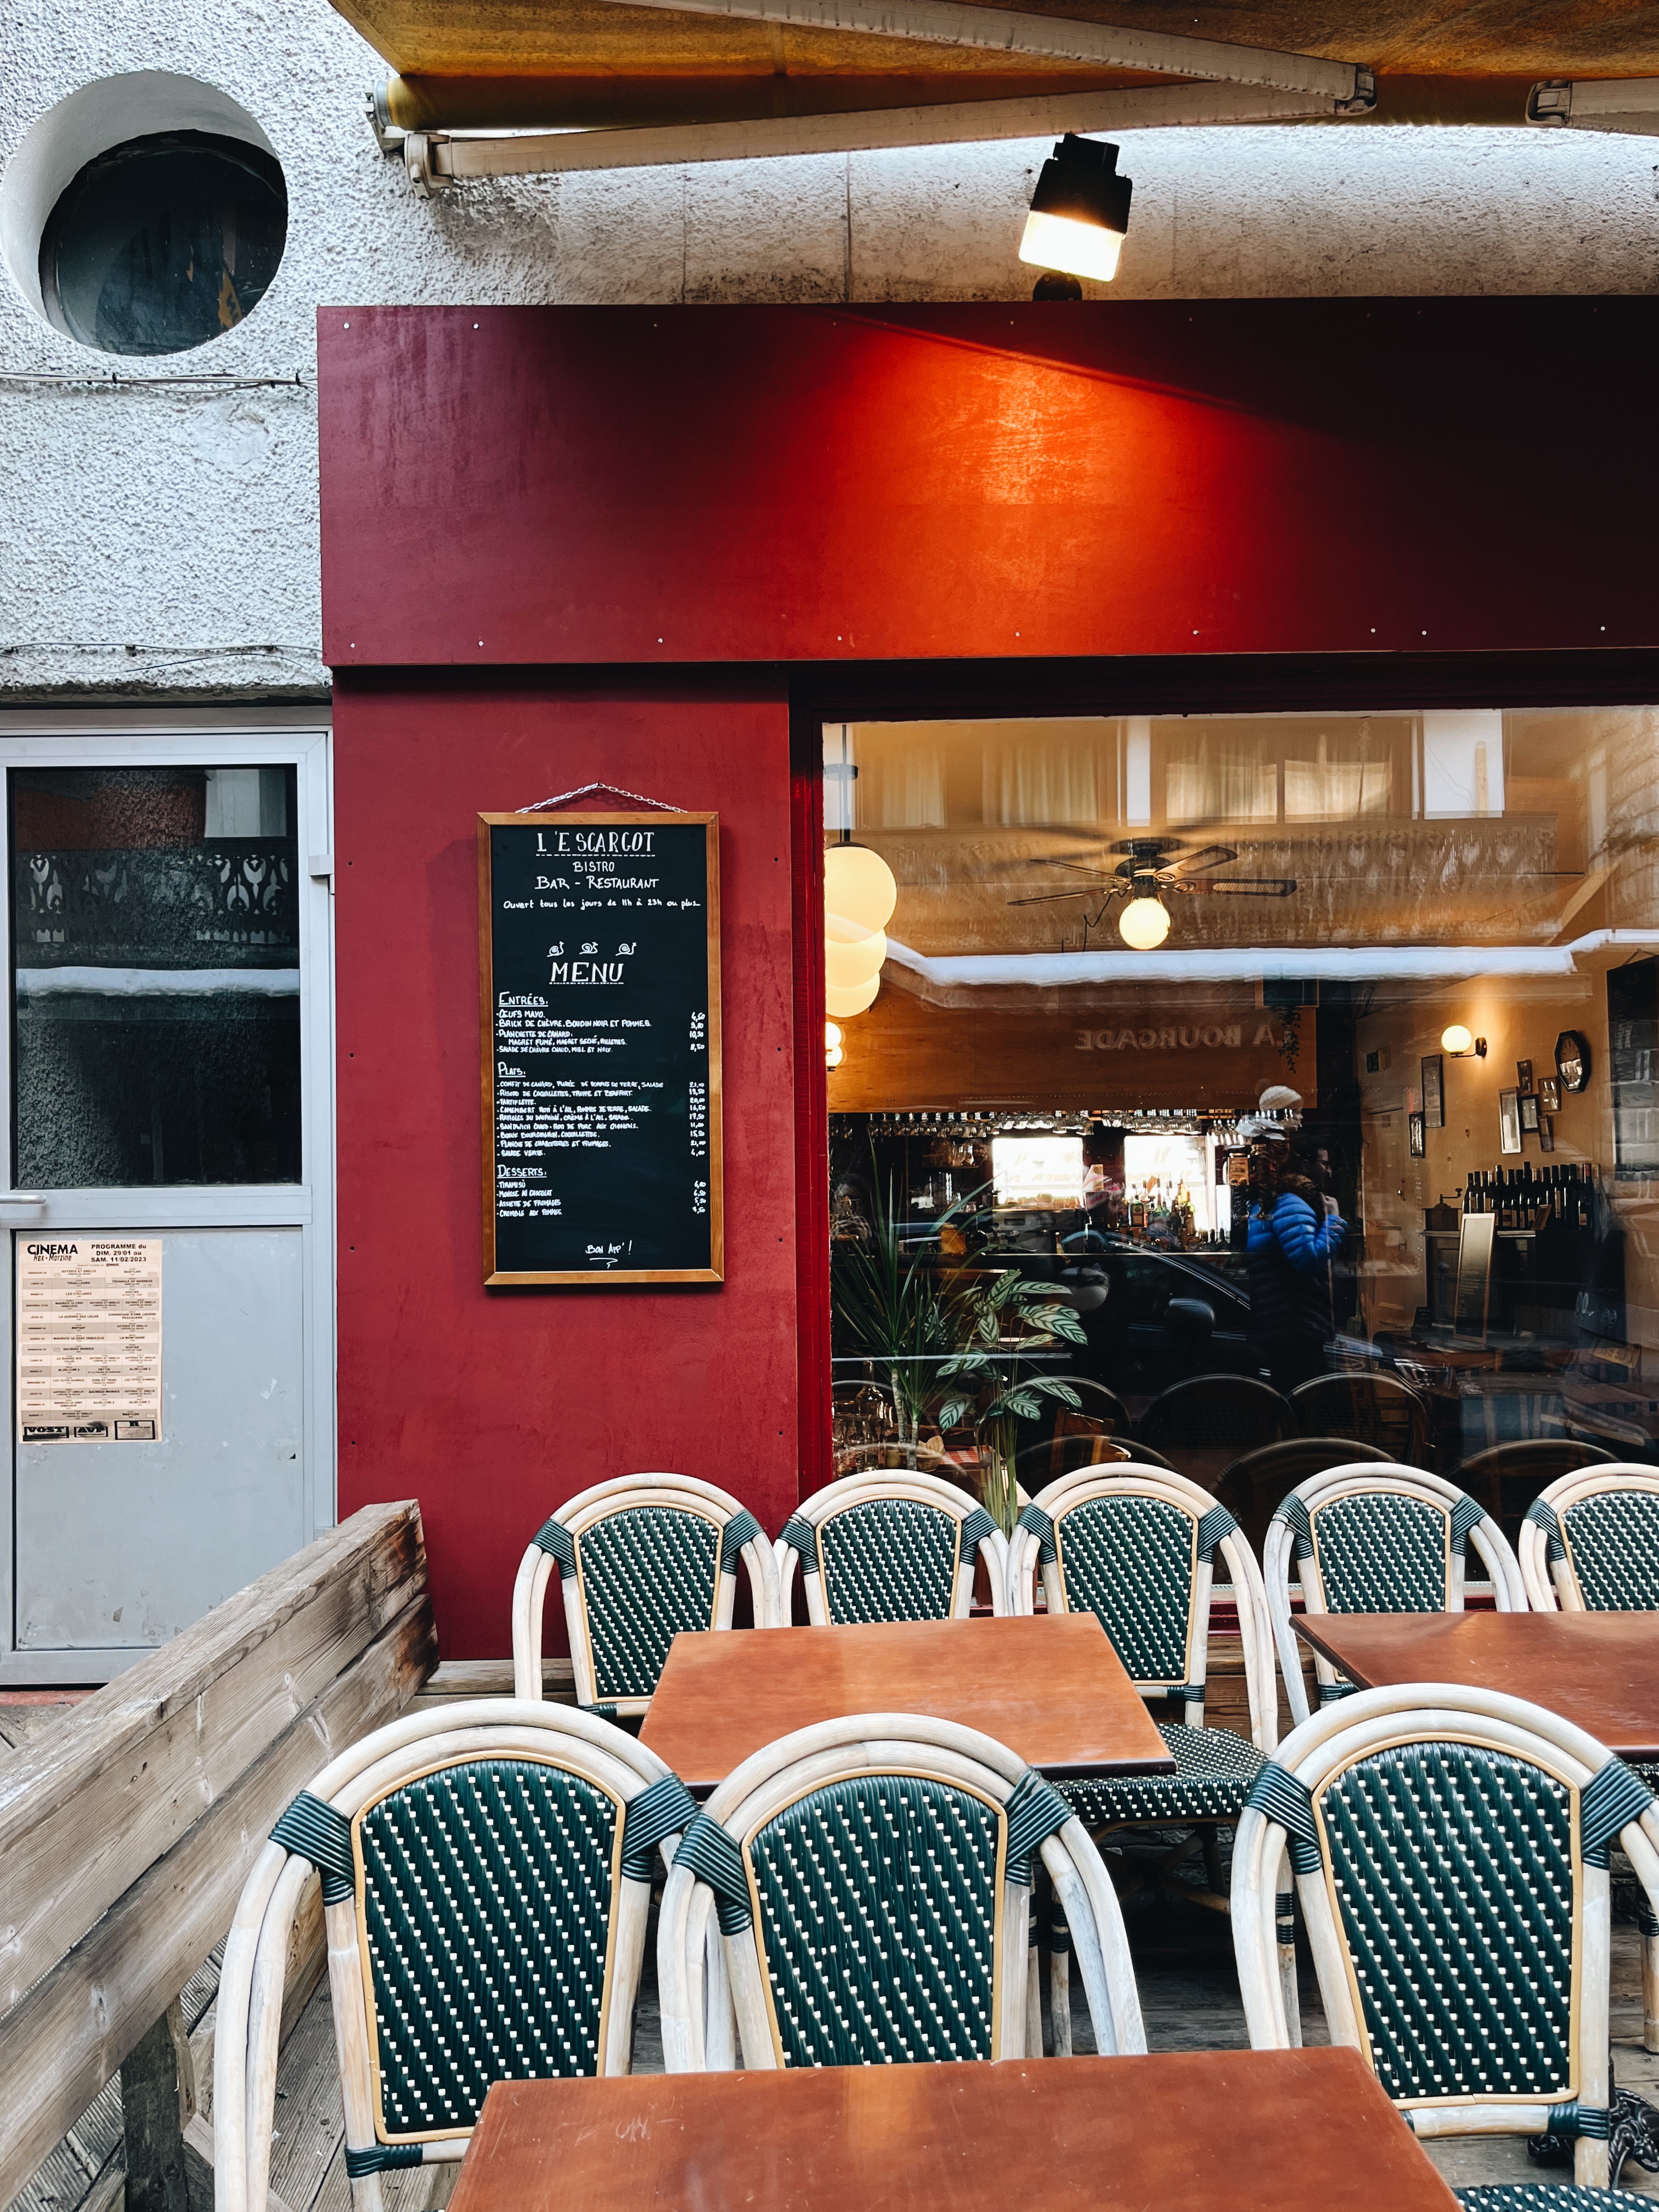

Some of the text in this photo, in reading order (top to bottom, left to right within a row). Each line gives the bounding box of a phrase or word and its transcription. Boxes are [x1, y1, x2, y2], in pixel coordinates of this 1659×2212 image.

[573, 861, 614, 872] BISTRO
[535, 876, 569, 889] BAR
[586, 876, 659, 889] RESTAURANT
[504, 900, 534, 909] Ouvert
[580, 899, 602, 910] jours
[551, 962, 624, 981] MENU
[499, 1019, 522, 1027] BRICK
[27, 1244, 78, 1255] CINEMA
